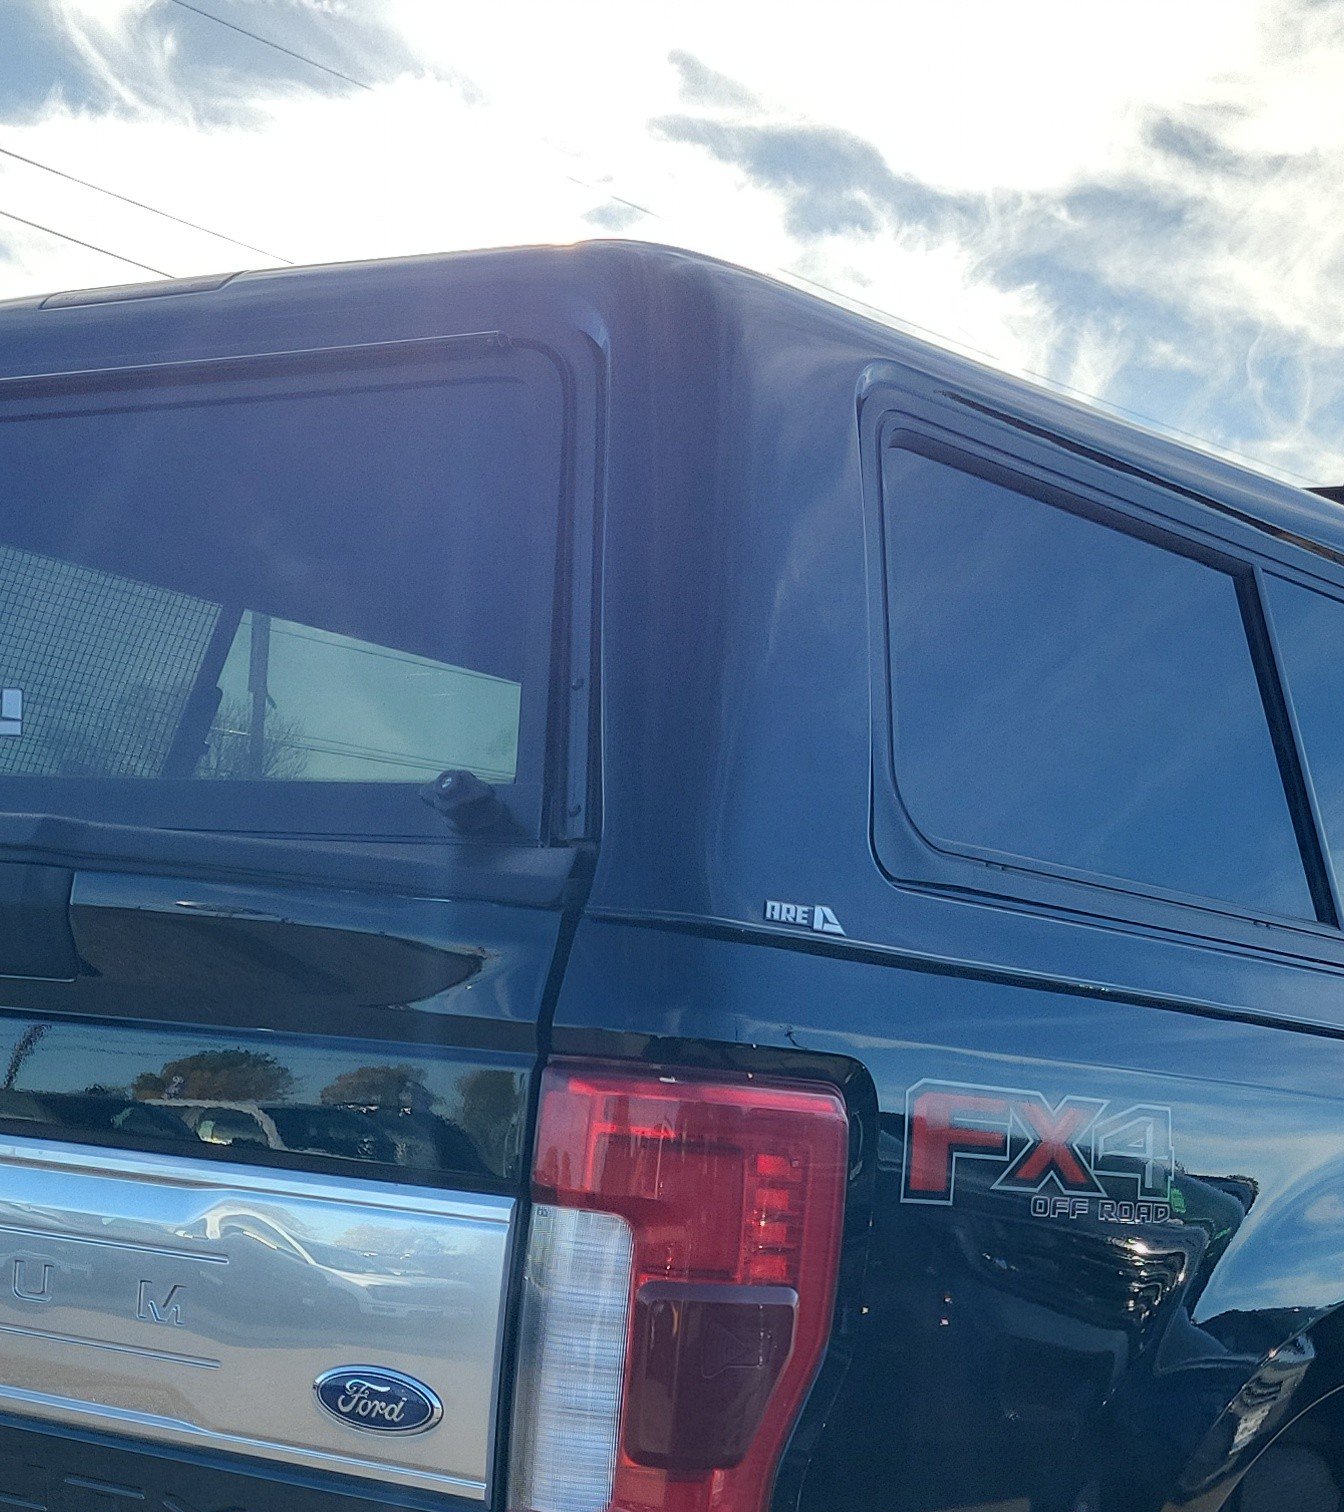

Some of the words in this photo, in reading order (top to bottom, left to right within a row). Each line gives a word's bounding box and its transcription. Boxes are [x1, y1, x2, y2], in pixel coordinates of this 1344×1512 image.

[764, 900, 814, 925] ARE
[900, 1077, 1175, 1206] FX4
[1031, 1195, 1089, 1219] OFF
[1098, 1201, 1172, 1223] ROAD
[337, 1379, 408, 1422] Ford
